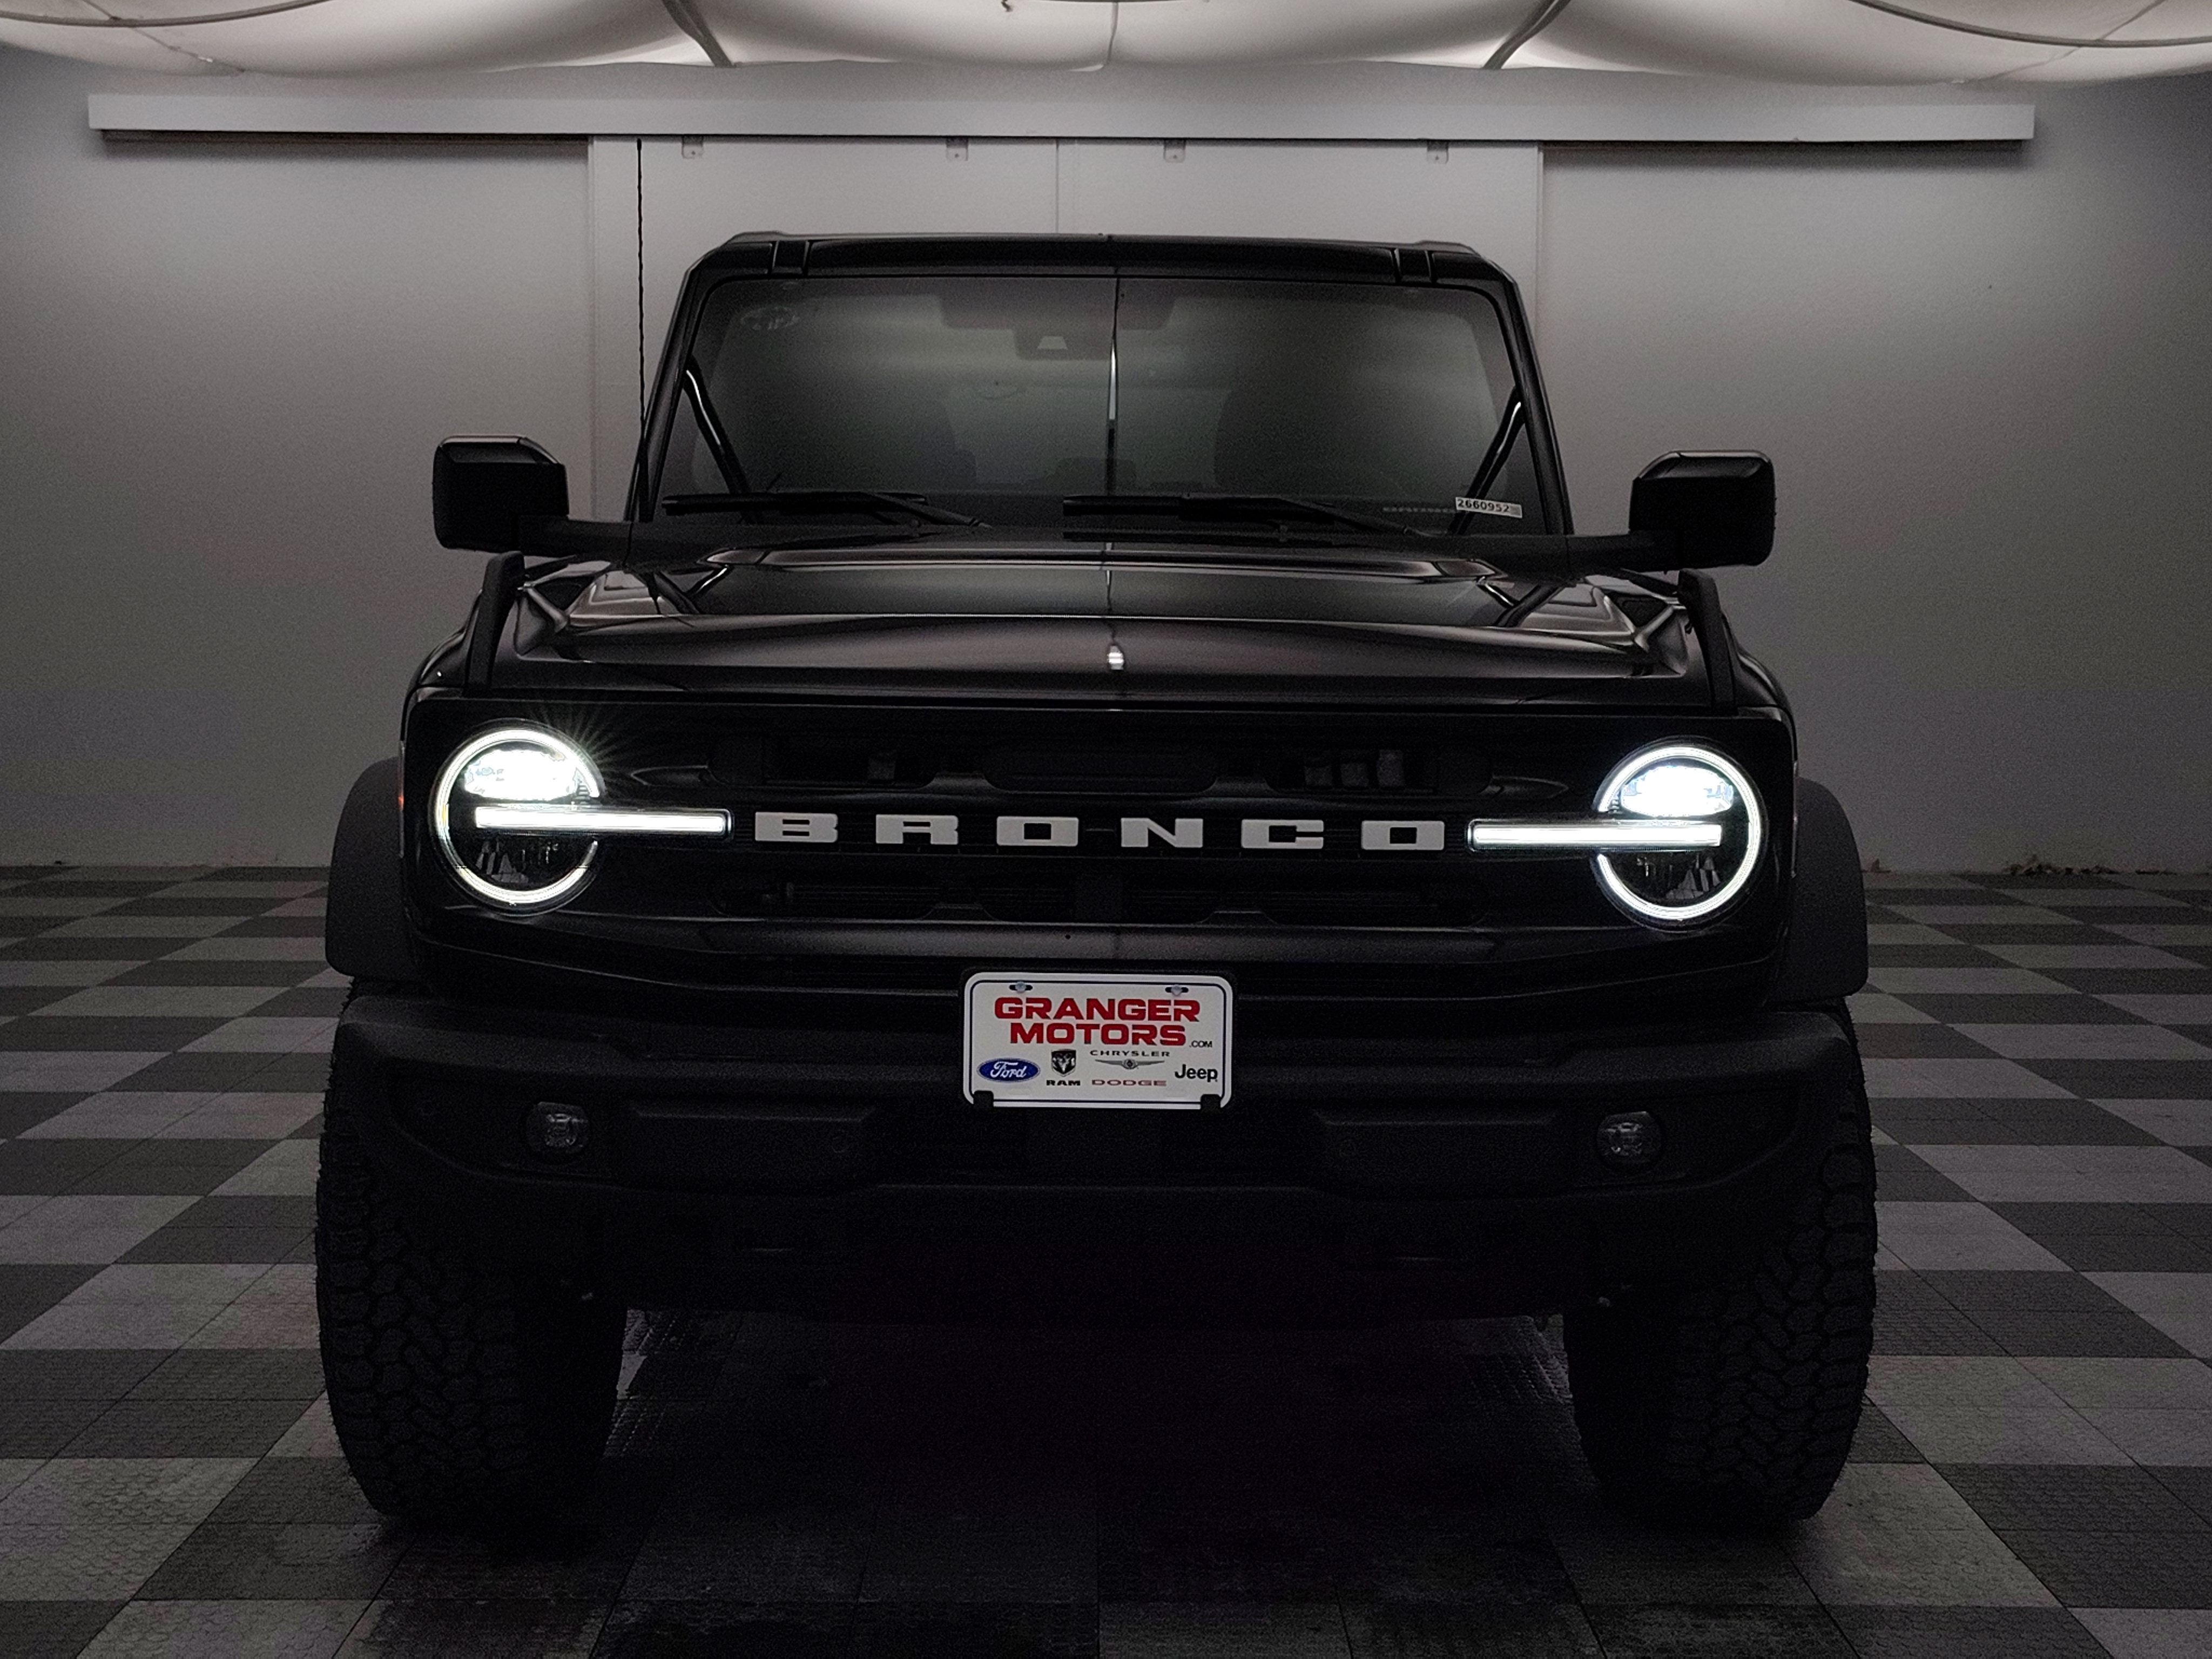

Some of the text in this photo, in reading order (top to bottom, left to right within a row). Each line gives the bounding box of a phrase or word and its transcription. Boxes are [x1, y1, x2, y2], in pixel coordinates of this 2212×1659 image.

[1457, 498, 1510, 512] 2660952
[754, 810, 1446, 851] BRONCO
[994, 997, 1201, 1022] GRANGER
[1010, 1022, 1187, 1046] MOTORS
[1089, 1049, 1170, 1057] CHRYSLER
[990, 1061, 1027, 1079] Ford
[1174, 1064, 1218, 1082] Jeep
